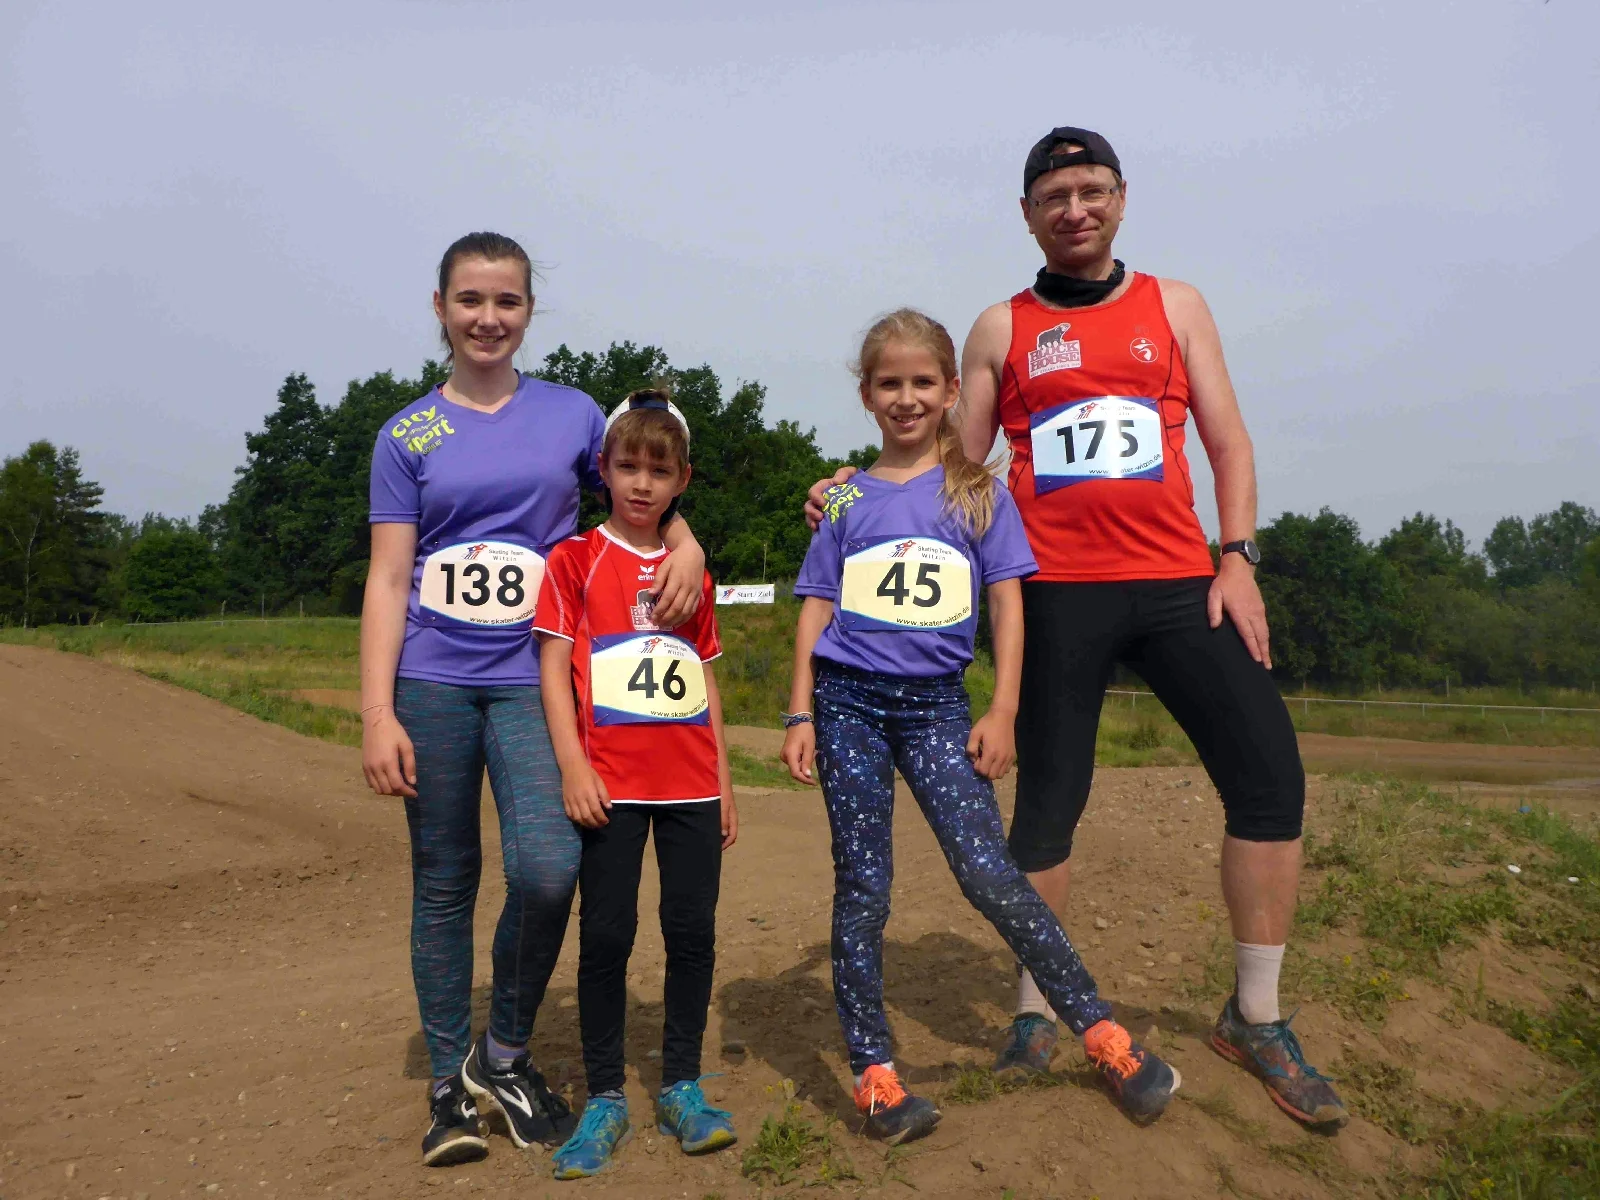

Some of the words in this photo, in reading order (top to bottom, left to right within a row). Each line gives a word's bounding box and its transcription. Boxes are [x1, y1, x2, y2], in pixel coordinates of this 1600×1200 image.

[1056, 419, 1139, 464] 175
[440, 563, 525, 607] 138
[637, 573, 655, 581] erim
[876, 562, 942, 608] 45
[896, 606, 970, 627] www.skater-witzin.de
[627, 657, 687, 701] 46
